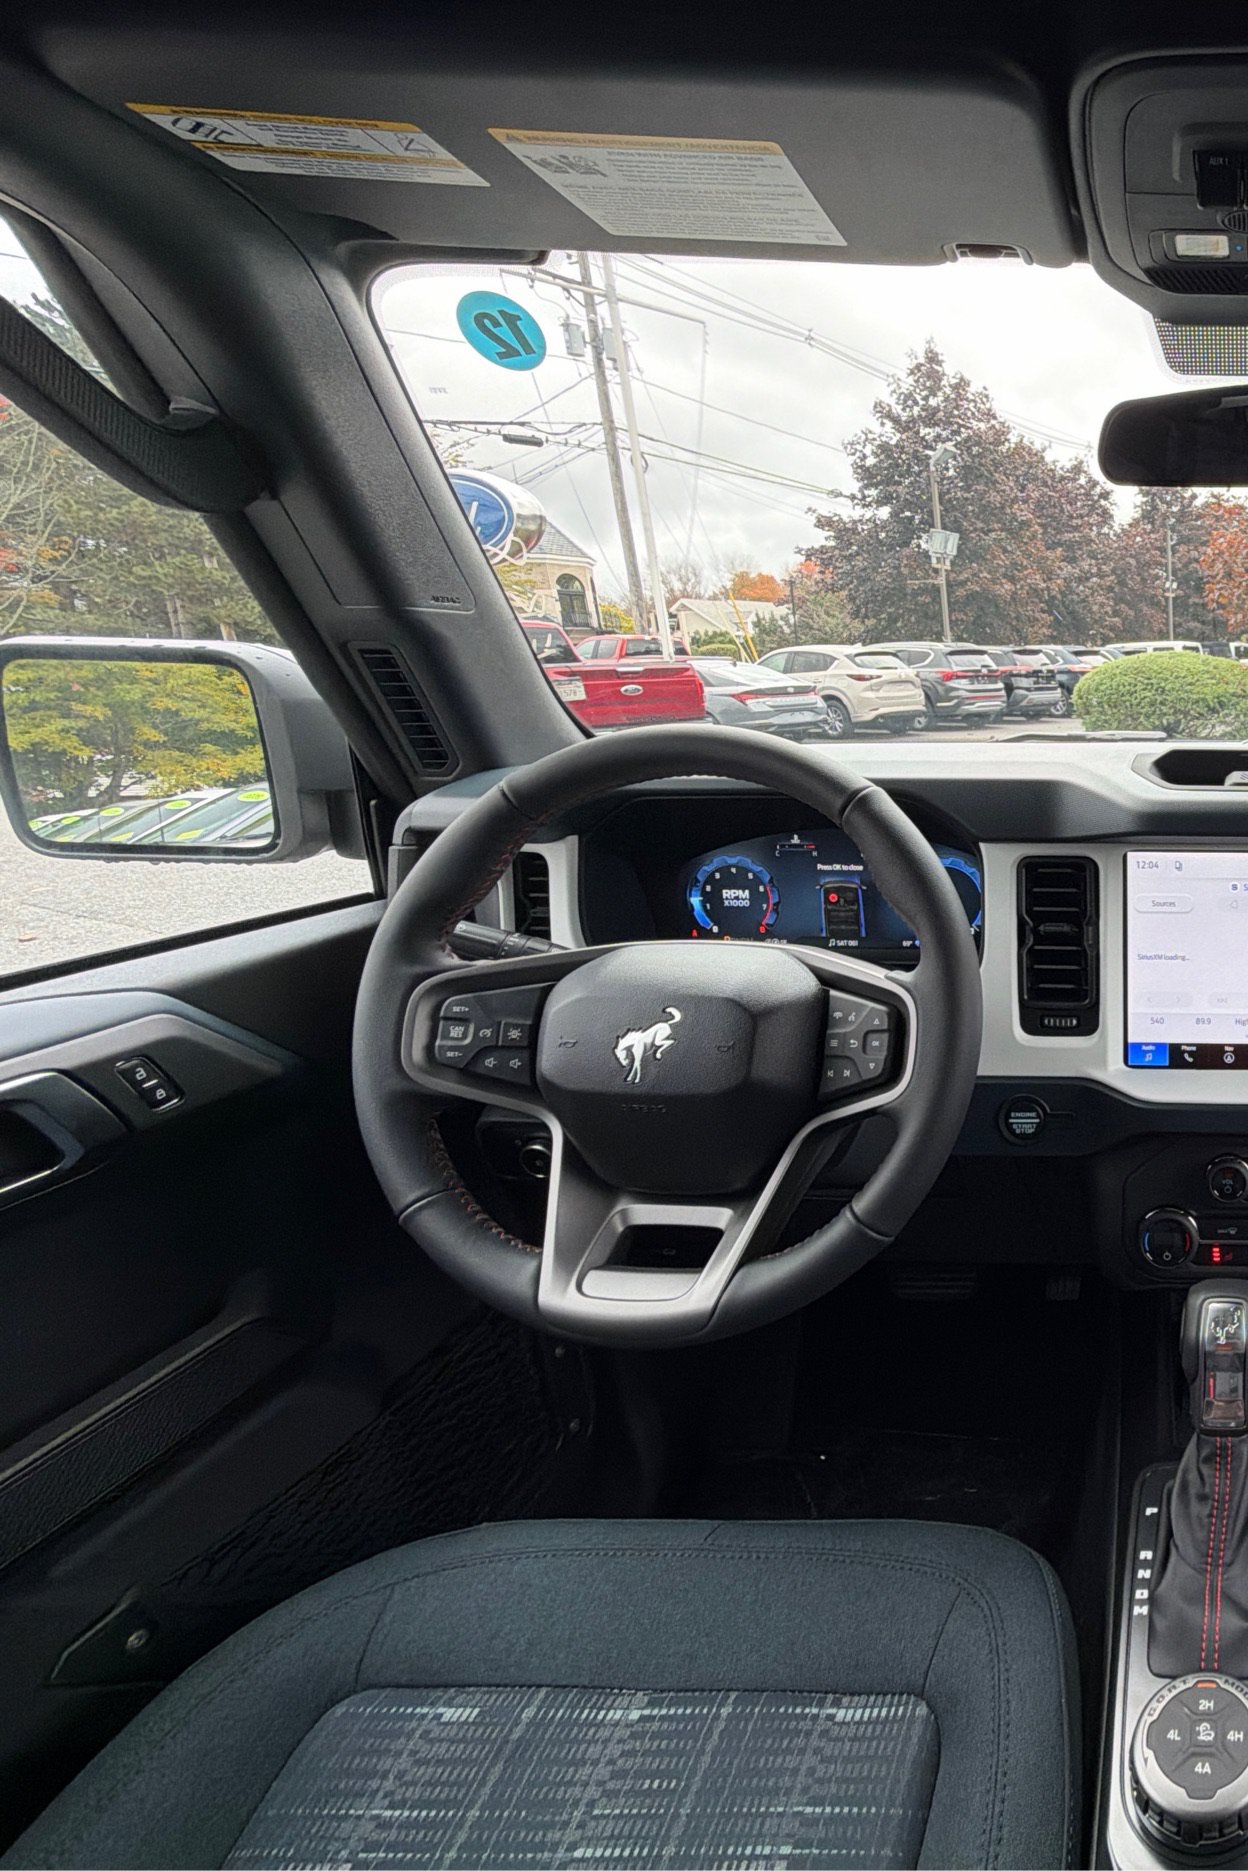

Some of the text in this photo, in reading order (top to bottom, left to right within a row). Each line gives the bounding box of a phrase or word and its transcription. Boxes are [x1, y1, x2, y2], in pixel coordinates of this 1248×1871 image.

[1136, 860, 1159, 869] 12:04
[722, 889, 750, 899] RPM
[1150, 1017, 1165, 1025] 540
[1195, 1017, 1212, 1025] 89.9
[1145, 1507, 1158, 1516] P
[1137, 1569, 1151, 1579] N
[1135, 1589, 1149, 1600] D
[1133, 1605, 1149, 1616] M
[1198, 1699, 1214, 1711] 2H
[1166, 1729, 1181, 1741] 4L
[1226, 1729, 1244, 1742] 4H
[1194, 1762, 1212, 1775] 4A
